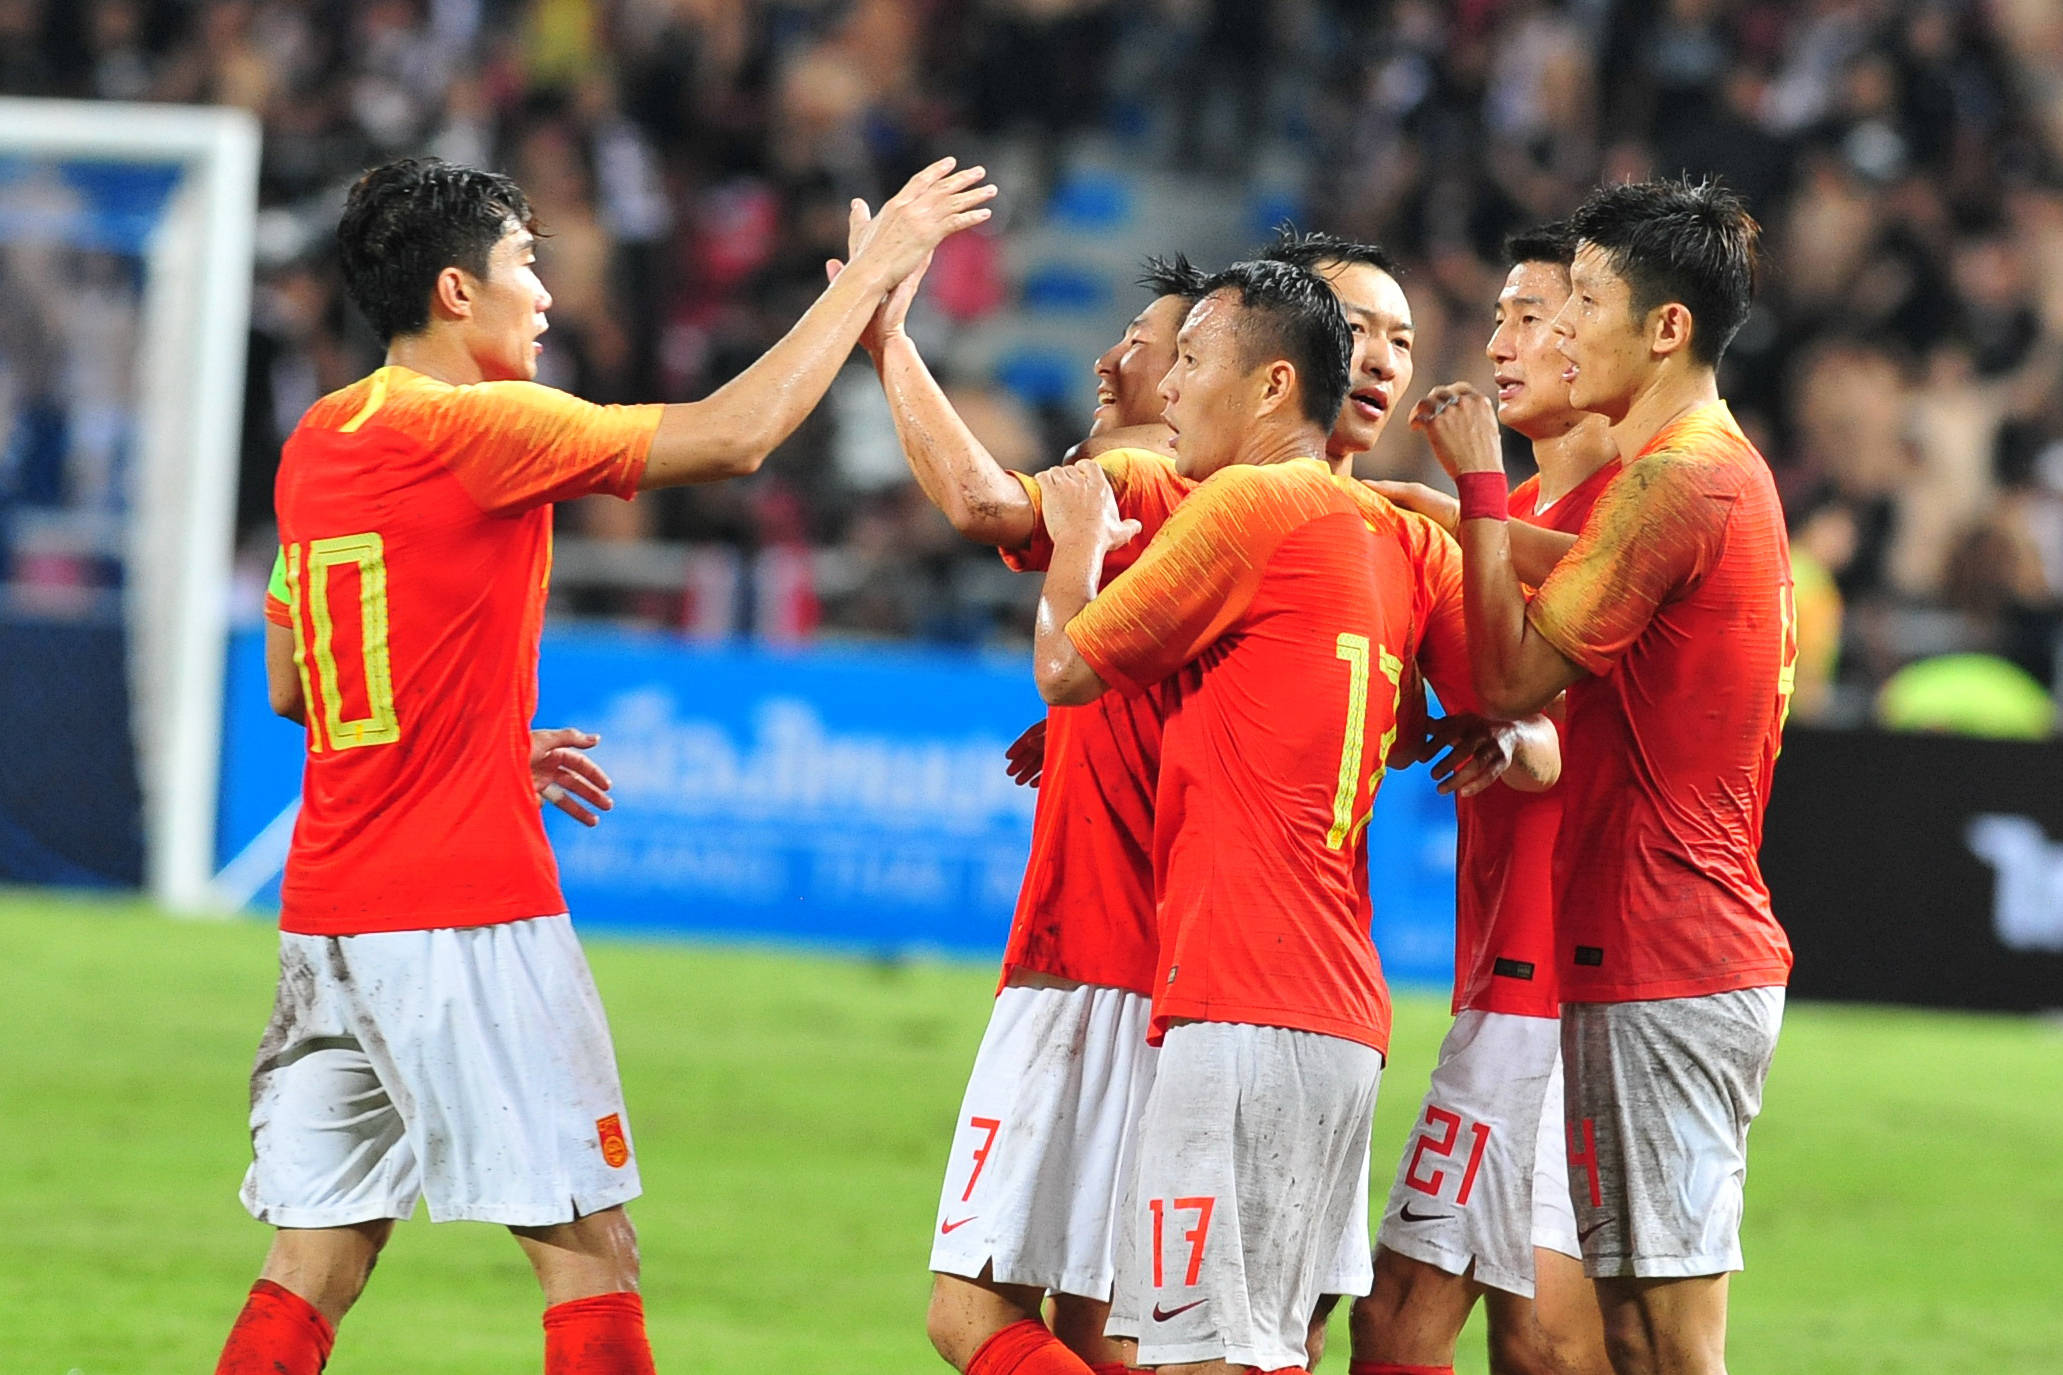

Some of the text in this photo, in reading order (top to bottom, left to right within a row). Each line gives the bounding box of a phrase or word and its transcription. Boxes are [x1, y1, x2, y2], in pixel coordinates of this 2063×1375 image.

[287, 532, 400, 753] 10
[961, 1116, 1001, 1202] 7
[1405, 1104, 1491, 1206] 21
[1567, 1118, 1603, 1208] 4
[1150, 1196, 1216, 1288] 17
